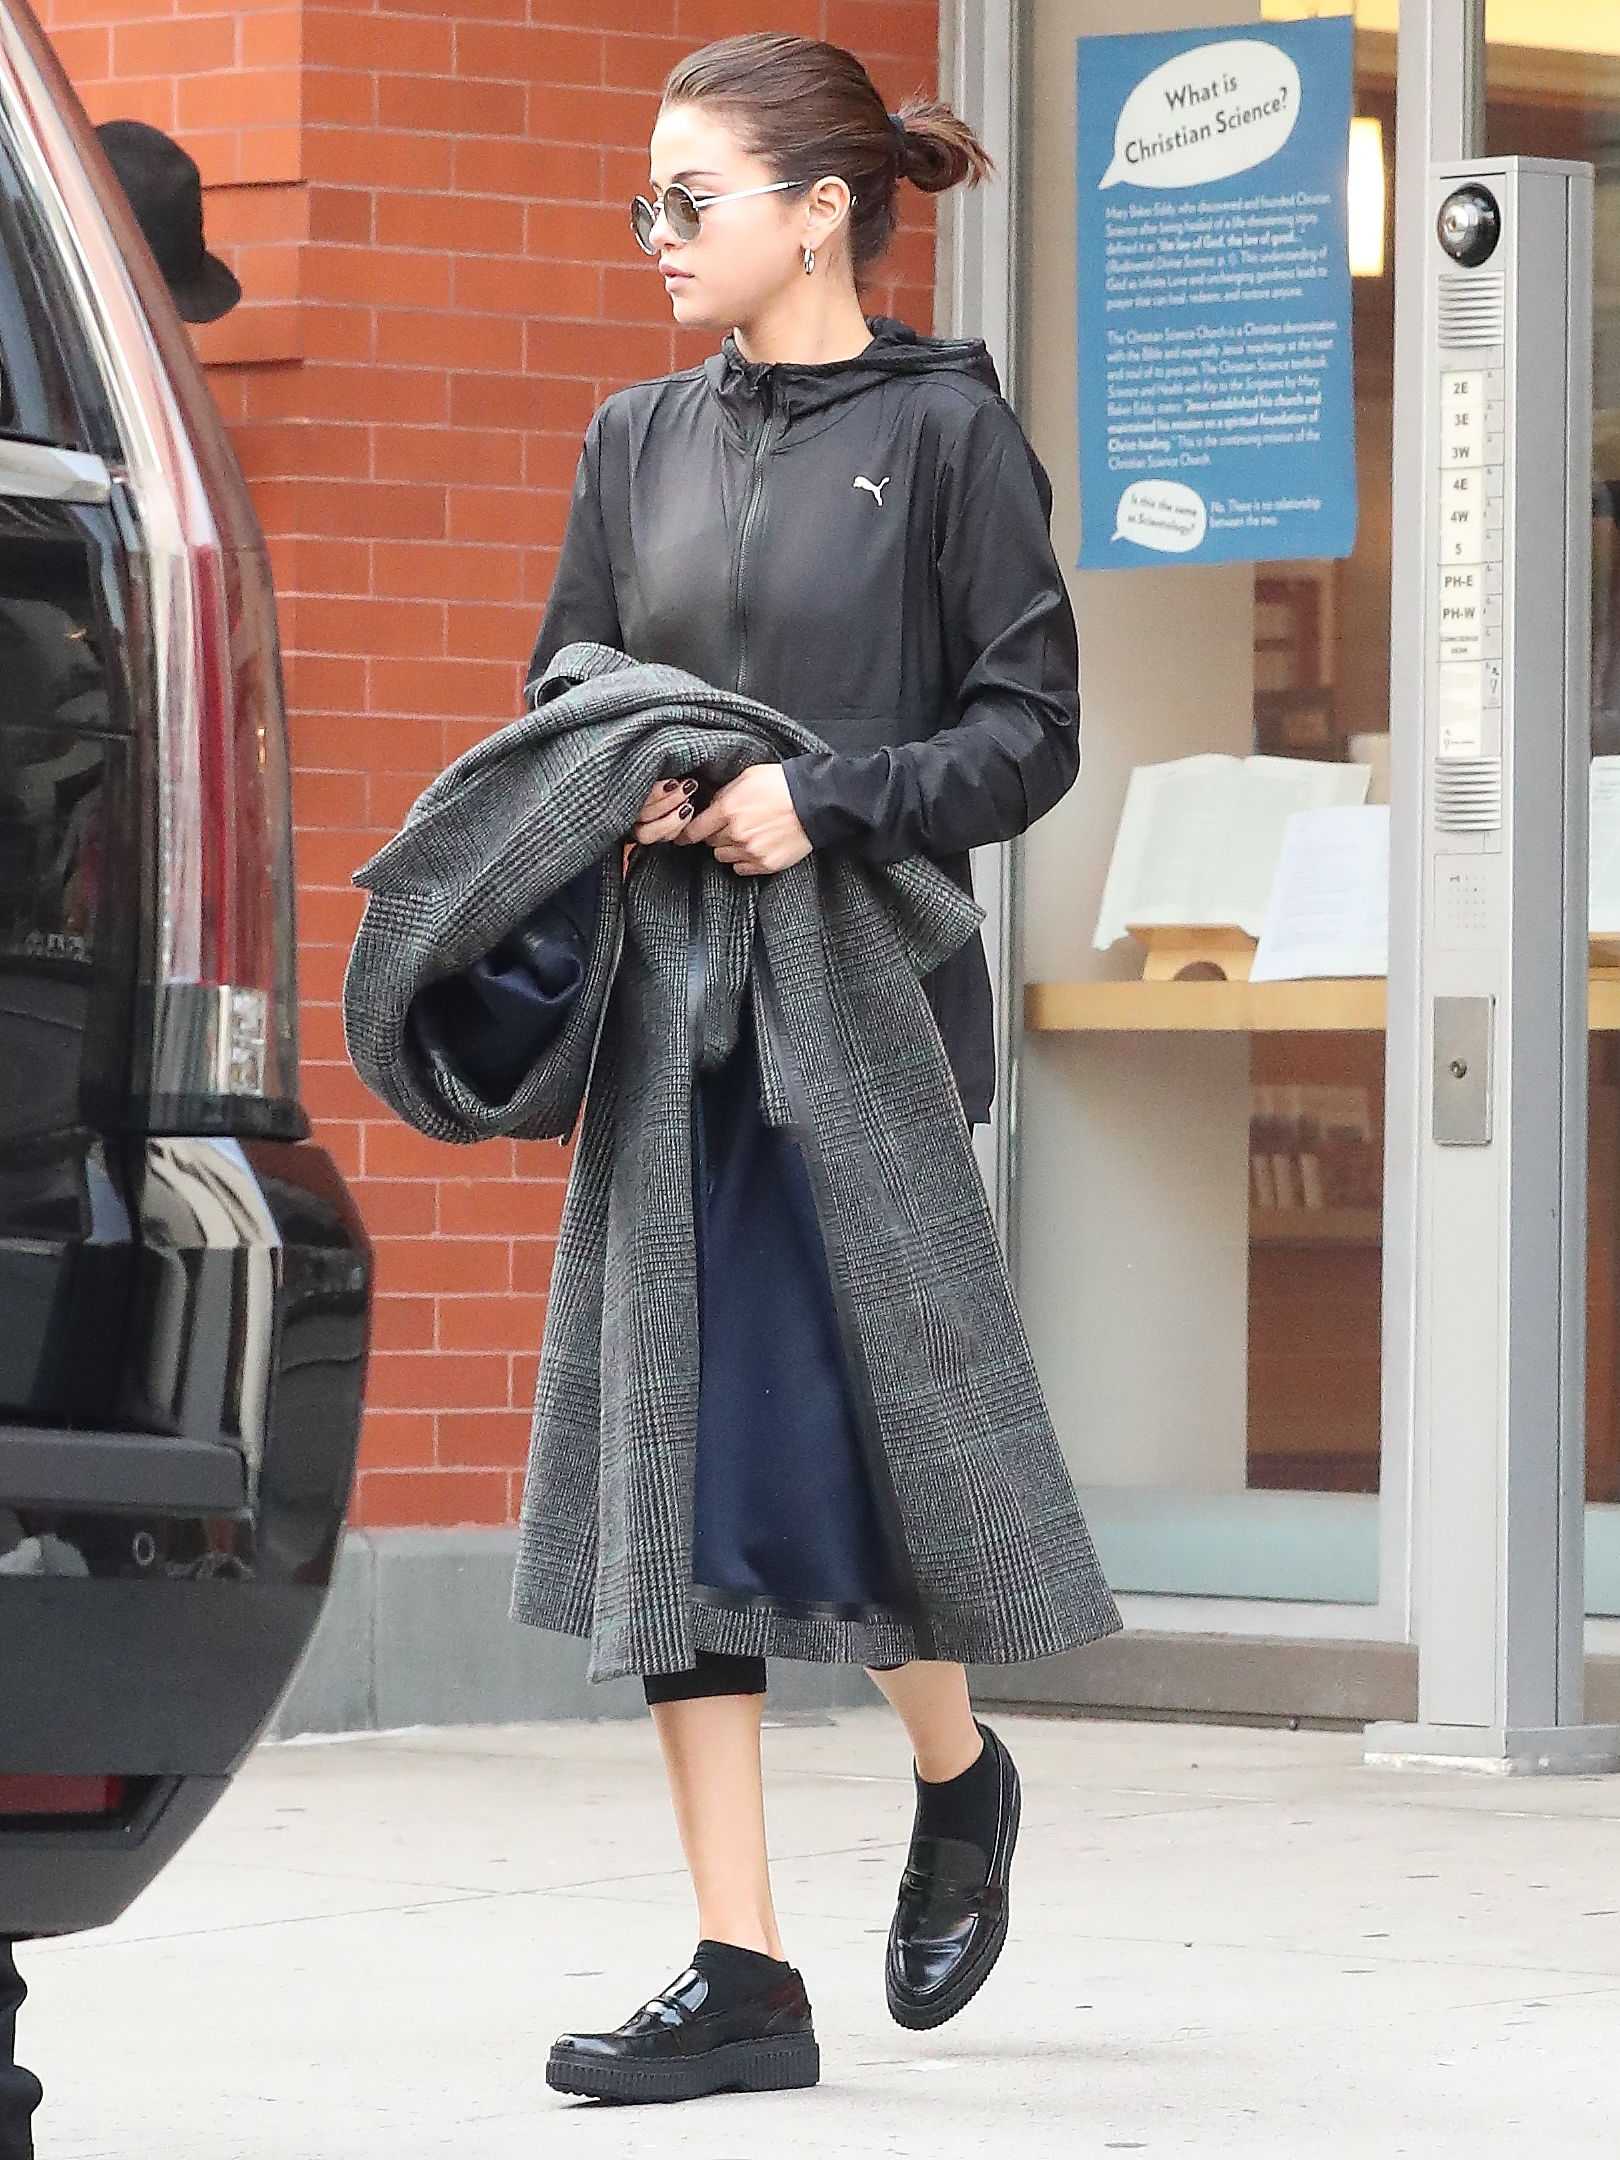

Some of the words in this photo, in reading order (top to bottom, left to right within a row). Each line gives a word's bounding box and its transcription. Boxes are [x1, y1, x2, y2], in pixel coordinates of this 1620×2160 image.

[1164, 81, 1220, 111] What
[1223, 73, 1239, 93] is
[1125, 125, 1211, 164] Christian
[1215, 86, 1288, 134] Science?
[1453, 382, 1468, 395] 2E
[1454, 413, 1469, 426] 3E
[1451, 446, 1470, 459] 3W
[1452, 478, 1468, 491] 4E
[1450, 511, 1469, 523] 4W
[1444, 576, 1473, 588] PH-E
[1442, 607, 1476, 620] PH-W
